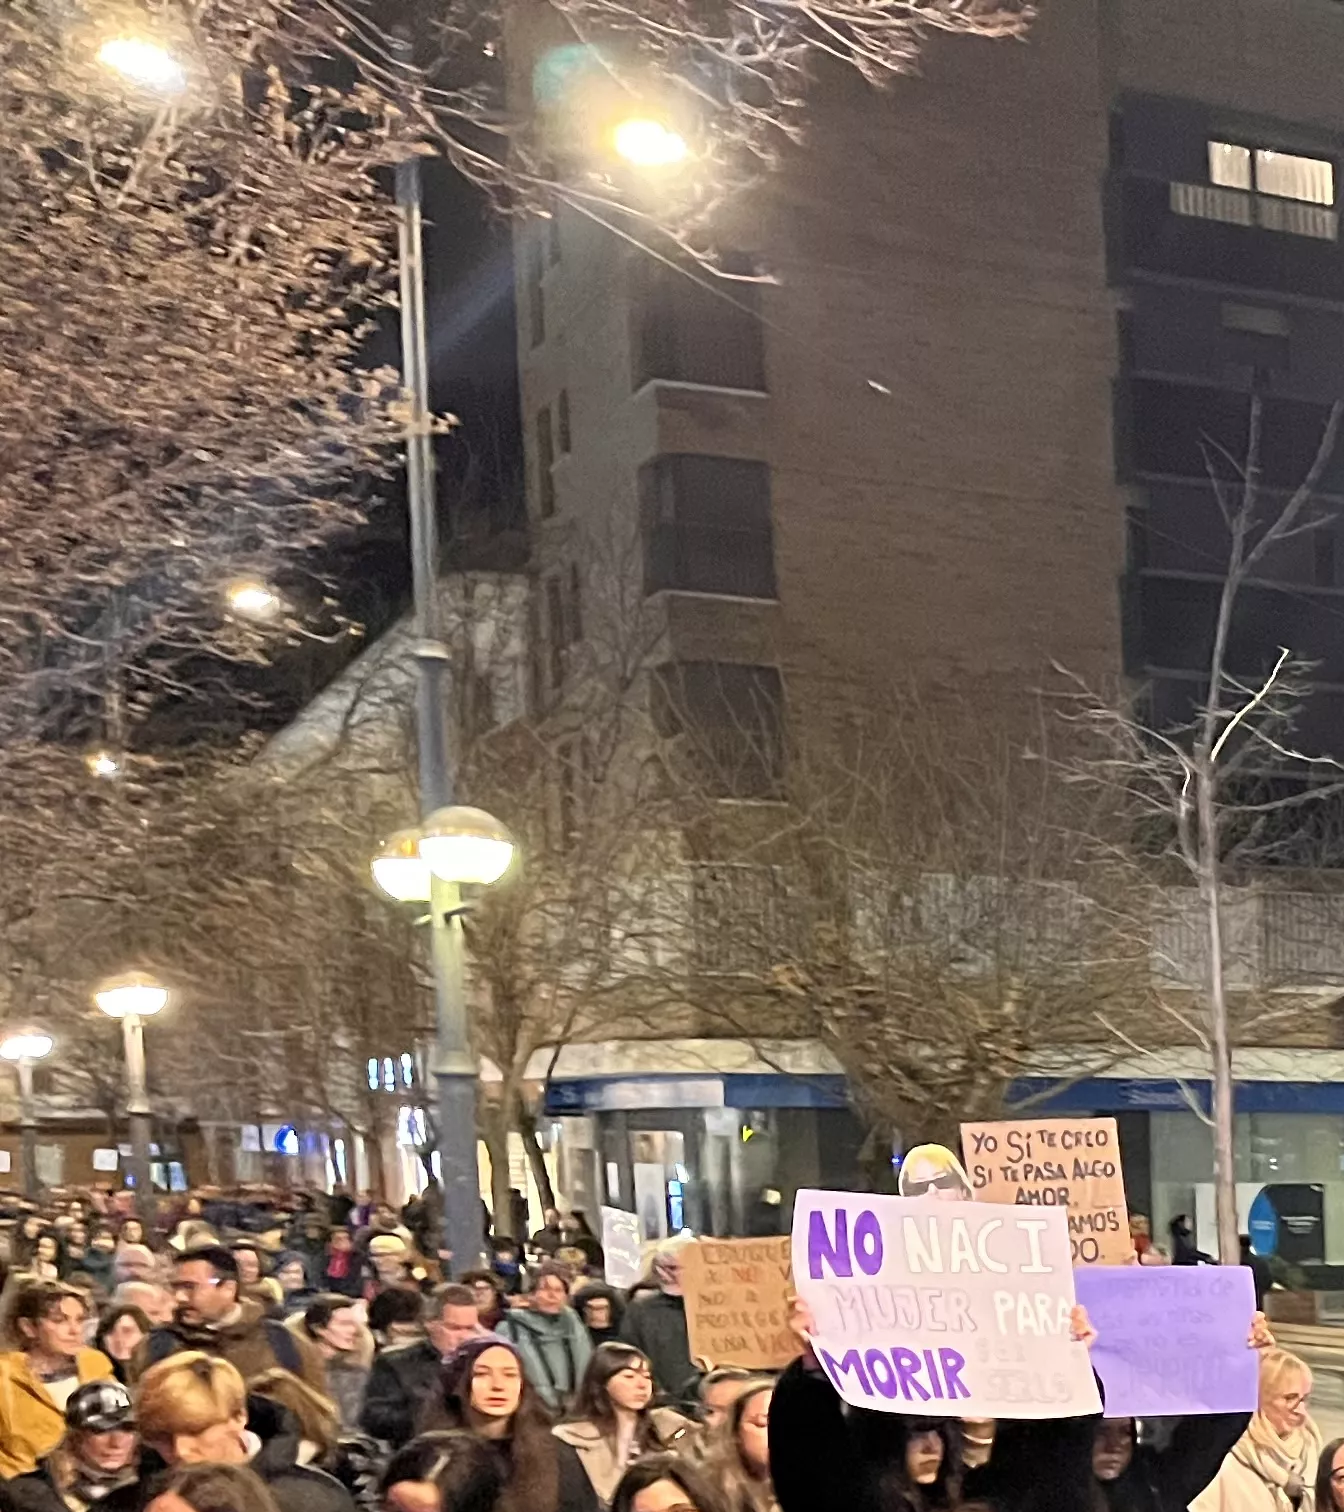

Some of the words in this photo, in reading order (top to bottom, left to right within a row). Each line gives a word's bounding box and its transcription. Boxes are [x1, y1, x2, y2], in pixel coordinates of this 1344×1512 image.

[971, 1132, 998, 1155] YO
[1036, 1129, 1057, 1148] TE
[1060, 1129, 1109, 1150] CREO
[972, 1165, 993, 1189] SI
[1000, 1166, 1019, 1182] TE
[1023, 1161, 1068, 1182] PASA
[1072, 1157, 1116, 1181] ALGO
[1067, 1209, 1120, 1234] AMOS
[807, 1208, 884, 1279] NO
[901, 1214, 1055, 1275] NACI
[828, 1283, 979, 1333] MUJER
[819, 1346, 972, 1402] MORIR
